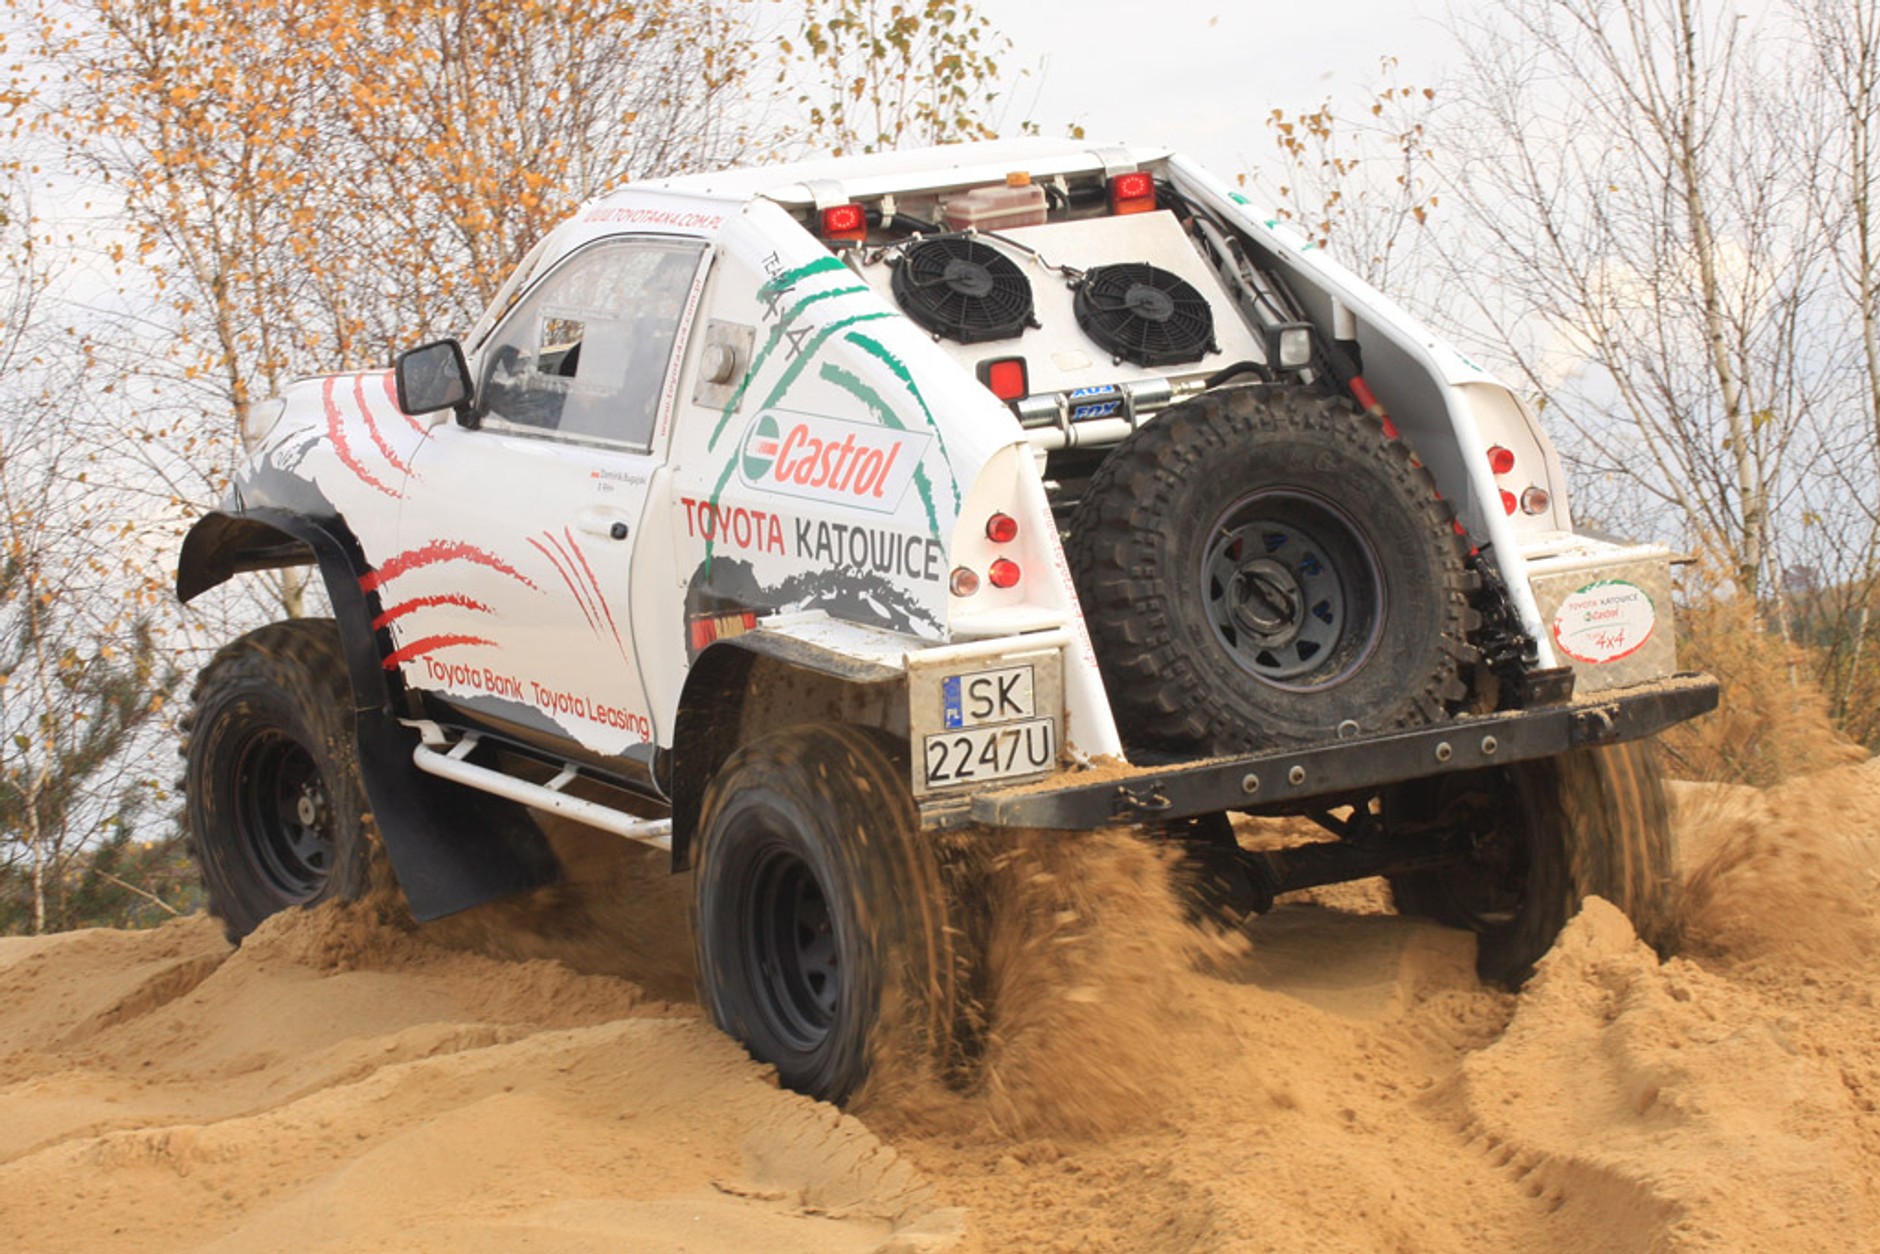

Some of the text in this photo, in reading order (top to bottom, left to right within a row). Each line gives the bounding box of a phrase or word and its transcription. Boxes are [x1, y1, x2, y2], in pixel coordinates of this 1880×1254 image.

[774, 423, 902, 498] Castrol
[681, 497, 940, 582] TOYOTA KATOWICE
[423, 655, 650, 743] Toyota Bank Toyota Leasing
[968, 673, 1024, 719] SK
[928, 725, 1050, 782] 2247U
